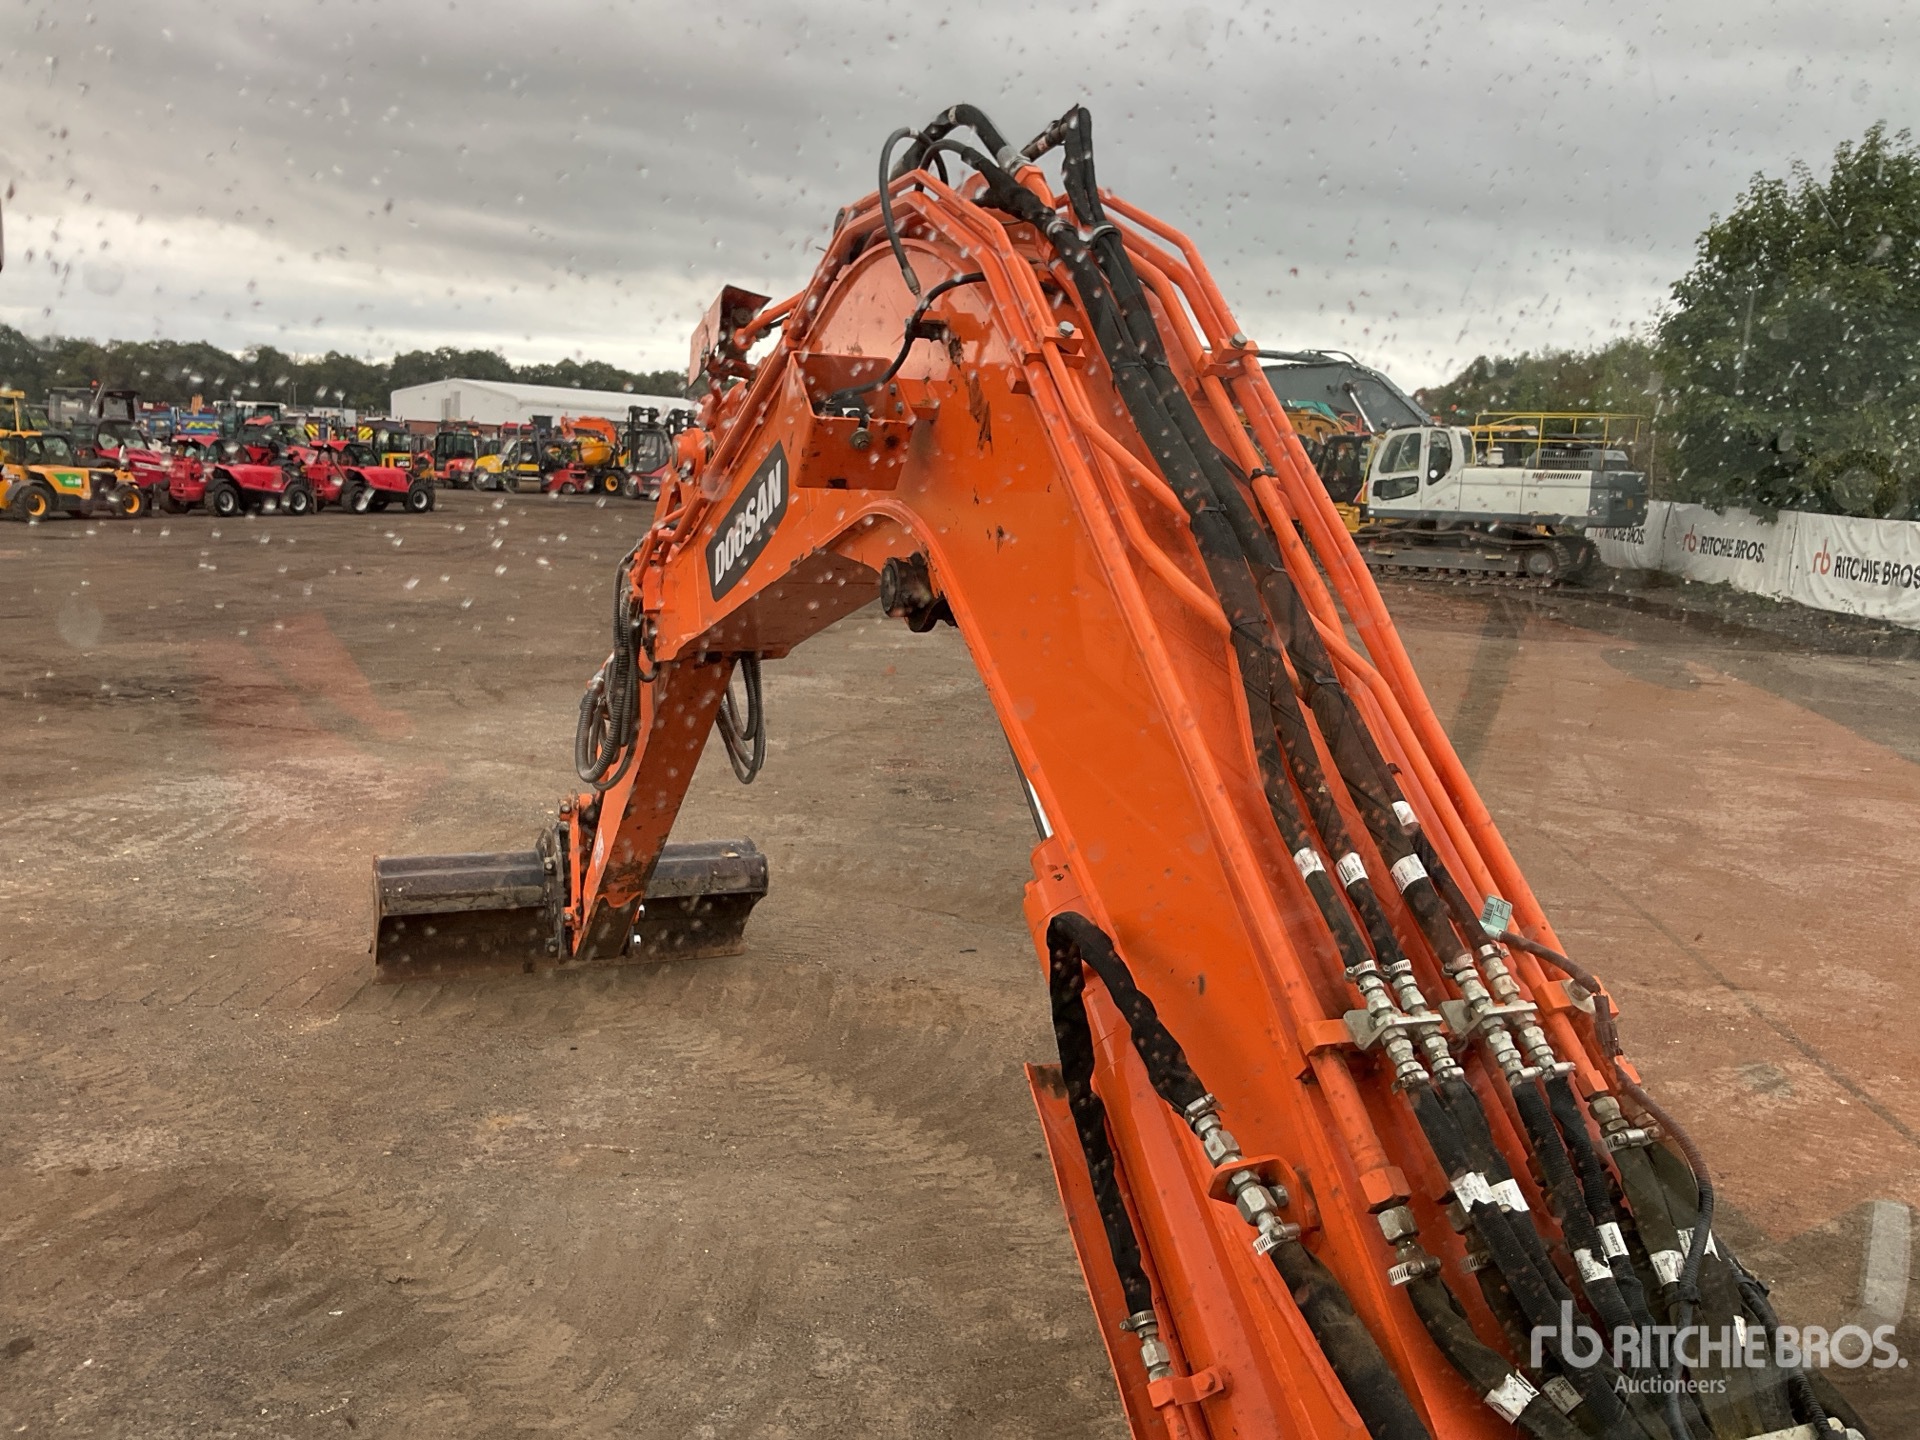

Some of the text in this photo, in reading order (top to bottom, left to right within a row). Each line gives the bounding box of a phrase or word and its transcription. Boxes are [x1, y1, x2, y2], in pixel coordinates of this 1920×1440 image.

[715, 459, 782, 586] DOOSAN
[1682, 524, 1765, 563] rb RITCHIE BROS.
[1812, 536, 1831, 575] rb
[1834, 555, 1881, 584] RITCHIE
